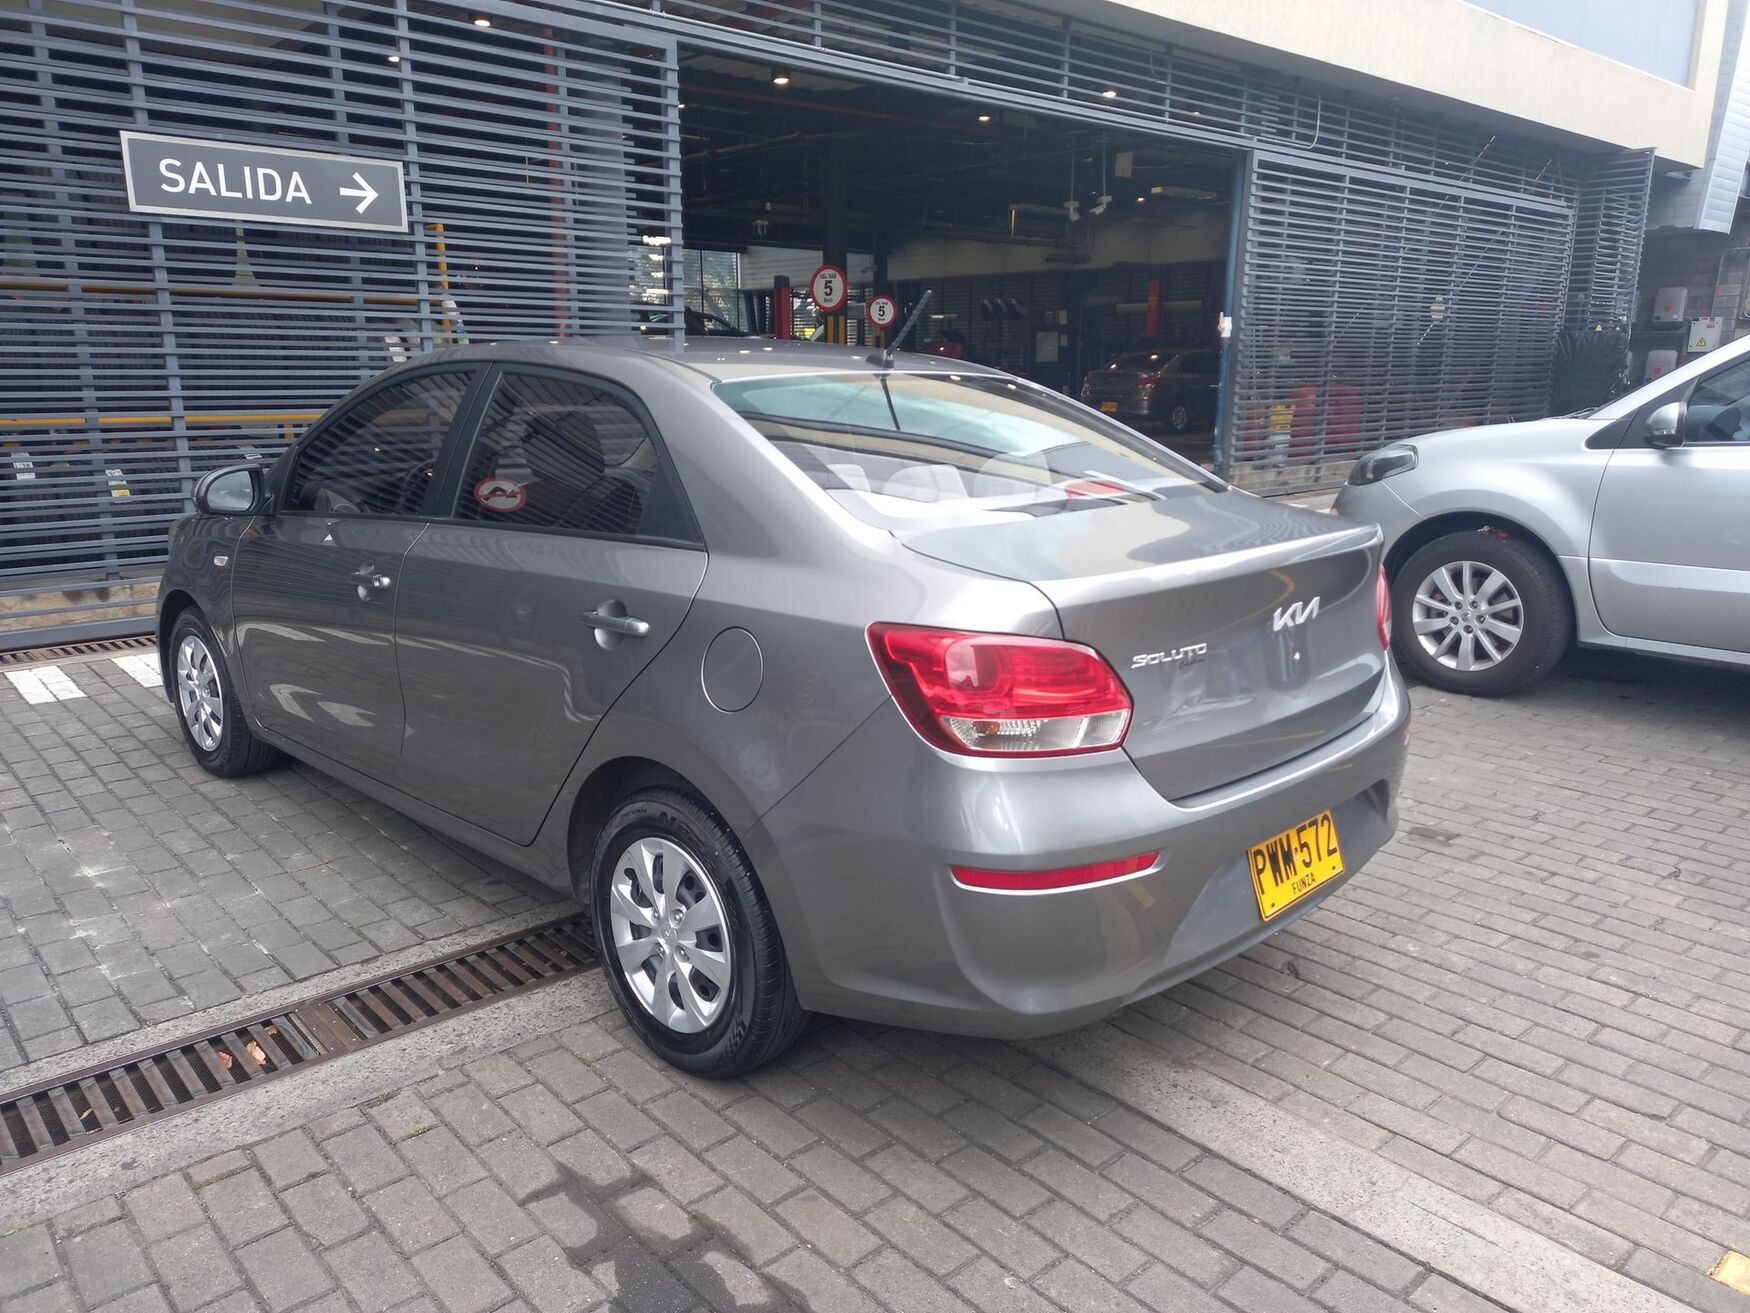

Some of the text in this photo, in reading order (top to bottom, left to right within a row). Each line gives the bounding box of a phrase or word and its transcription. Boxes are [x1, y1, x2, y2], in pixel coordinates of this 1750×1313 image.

[159, 158, 312, 205] SALIDA
[824, 280, 833, 297] 5
[878, 305, 886, 317] 5
[1273, 596, 1320, 632] KIA
[1131, 643, 1207, 668] SOLUTO
[1292, 872, 1316, 895] FUNZA
